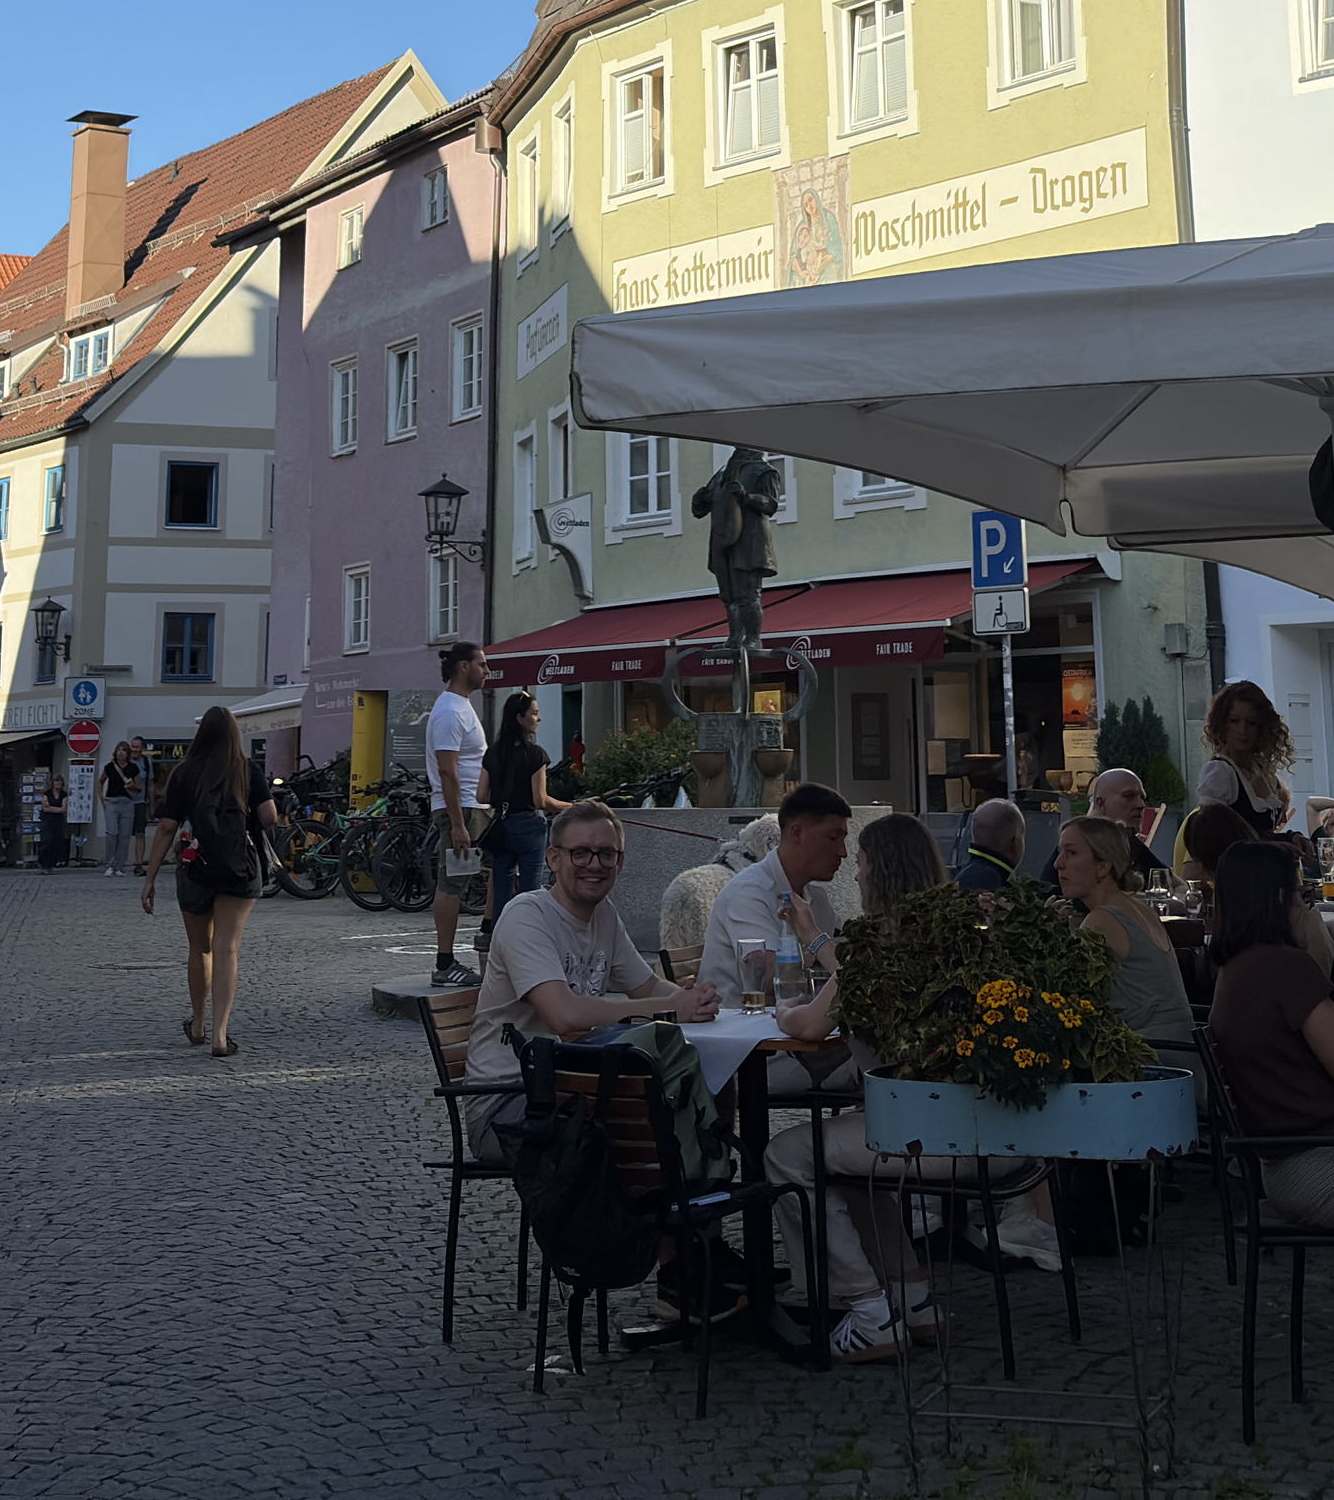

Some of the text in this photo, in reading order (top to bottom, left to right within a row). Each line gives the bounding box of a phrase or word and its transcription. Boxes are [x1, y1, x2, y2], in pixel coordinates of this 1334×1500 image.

[853, 182, 987, 259] Waschmittel
[1029, 162, 1128, 214] Drogen
[665, 236, 774, 300] Kottermair
[979, 519, 1007, 578] P
[797, 648, 831, 659] ELTLADEN
[876, 642, 913, 655] FAIR TRADE
[545, 665, 575, 676] WELTLADEN
[611, 659, 642, 672] FAIR TRADE
[28, 704, 61, 725] FICHTL
[74, 707, 95, 716] ZONE
